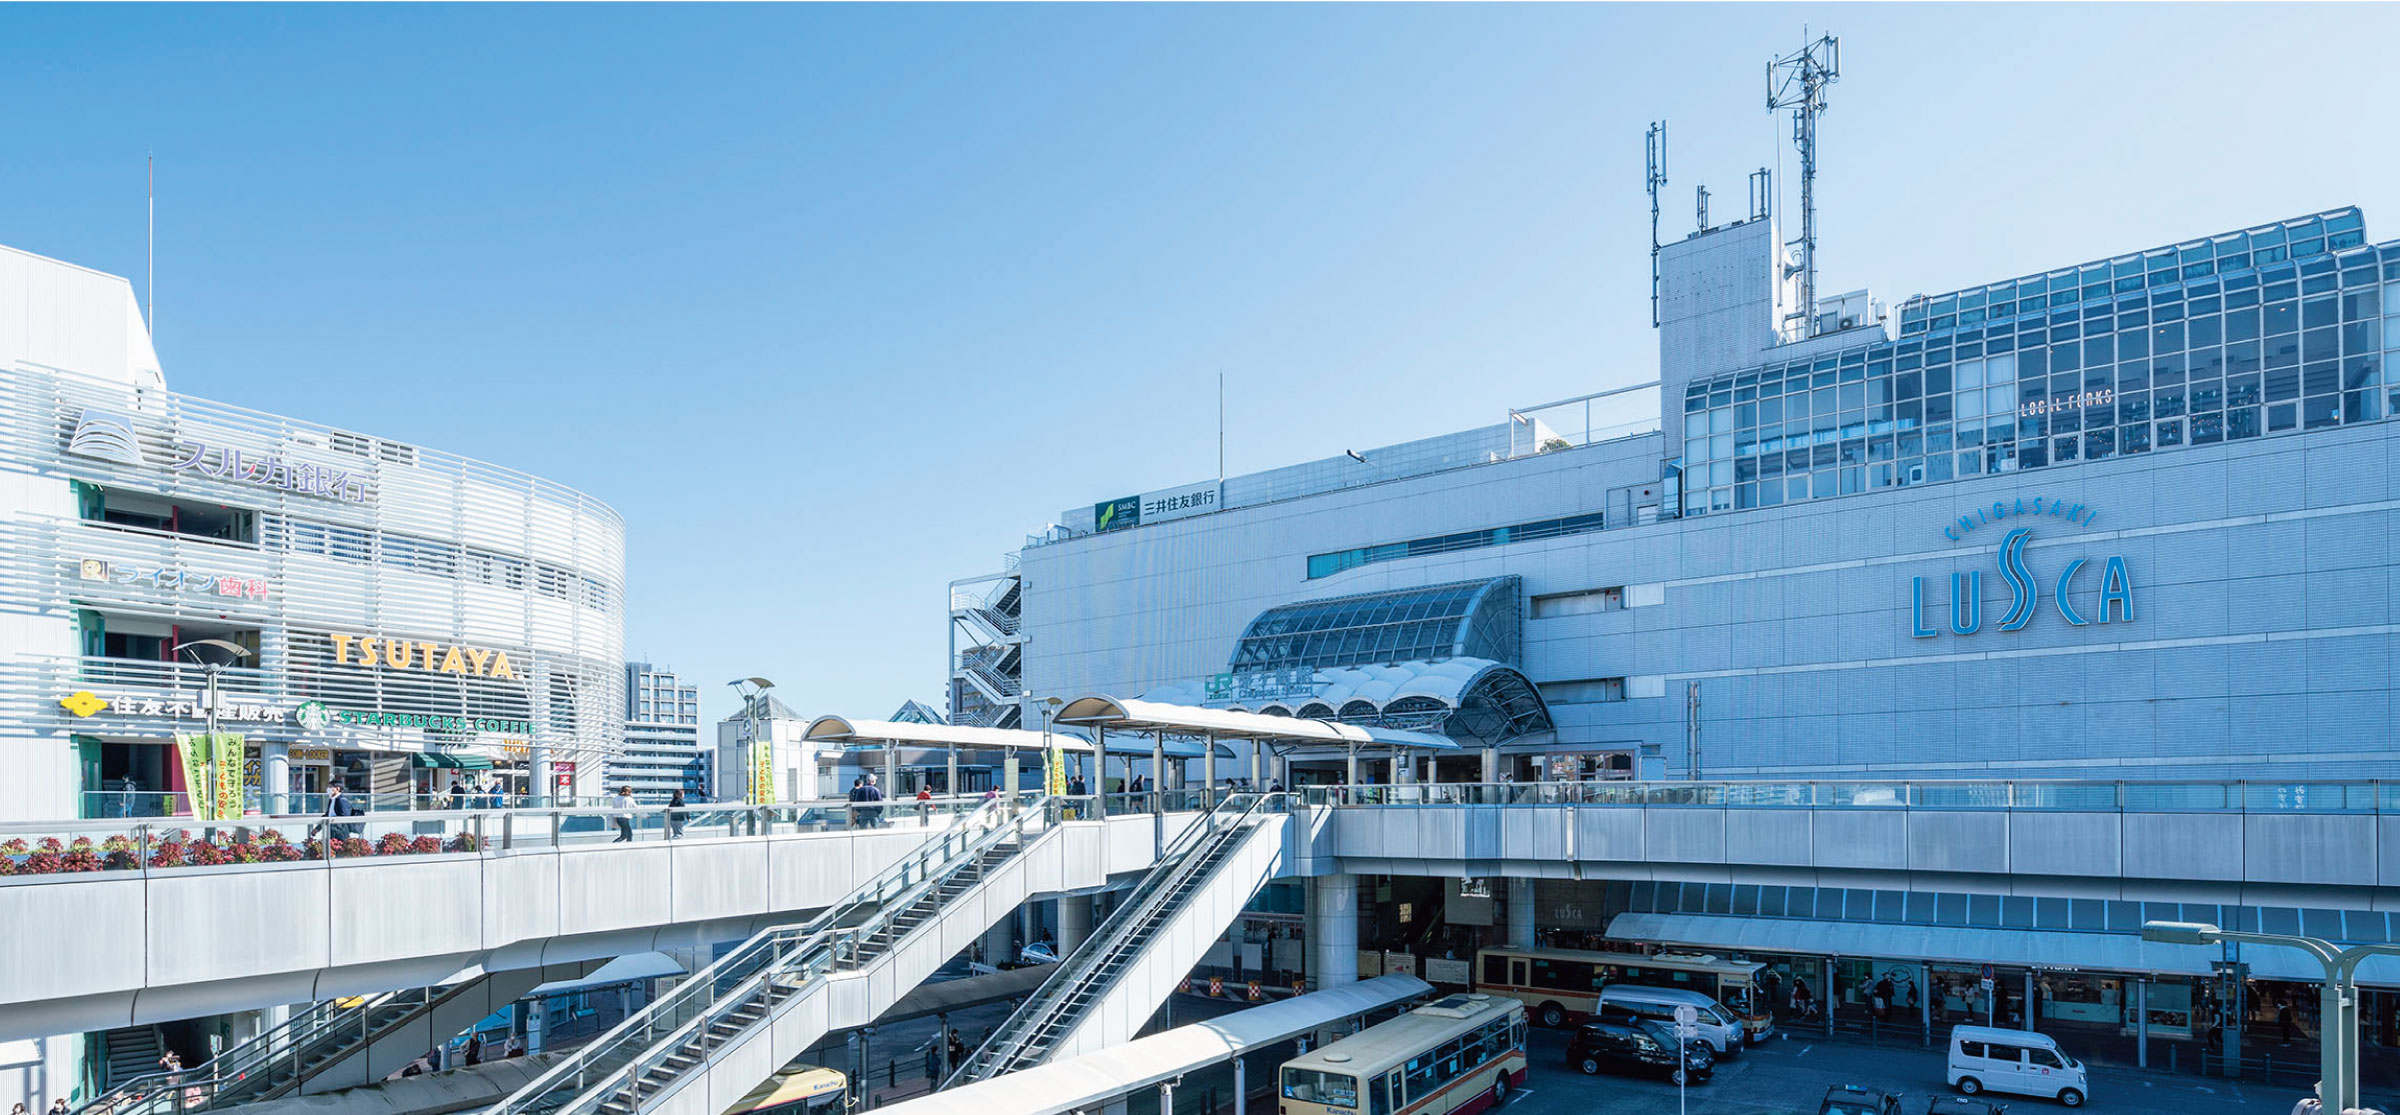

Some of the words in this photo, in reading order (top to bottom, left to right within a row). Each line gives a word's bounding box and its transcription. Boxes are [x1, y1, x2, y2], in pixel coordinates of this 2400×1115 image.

[2021, 397, 2062, 417] LOCL
[171, 439, 370, 503] スルガ銀行
[1143, 489, 1216, 516] 三井住友銀行
[1944, 496, 2097, 541] CHIGASAKI
[114, 563, 270, 601] ライオン歯科
[1911, 527, 2134, 639] LUSCA
[330, 633, 515, 680] TSUTAYA
[1204, 672, 1234, 693] JR
[338, 709, 467, 730] STARBUCKS
[474, 717, 537, 735] COFFEE
[1554, 903, 1583, 920] LUSCA
